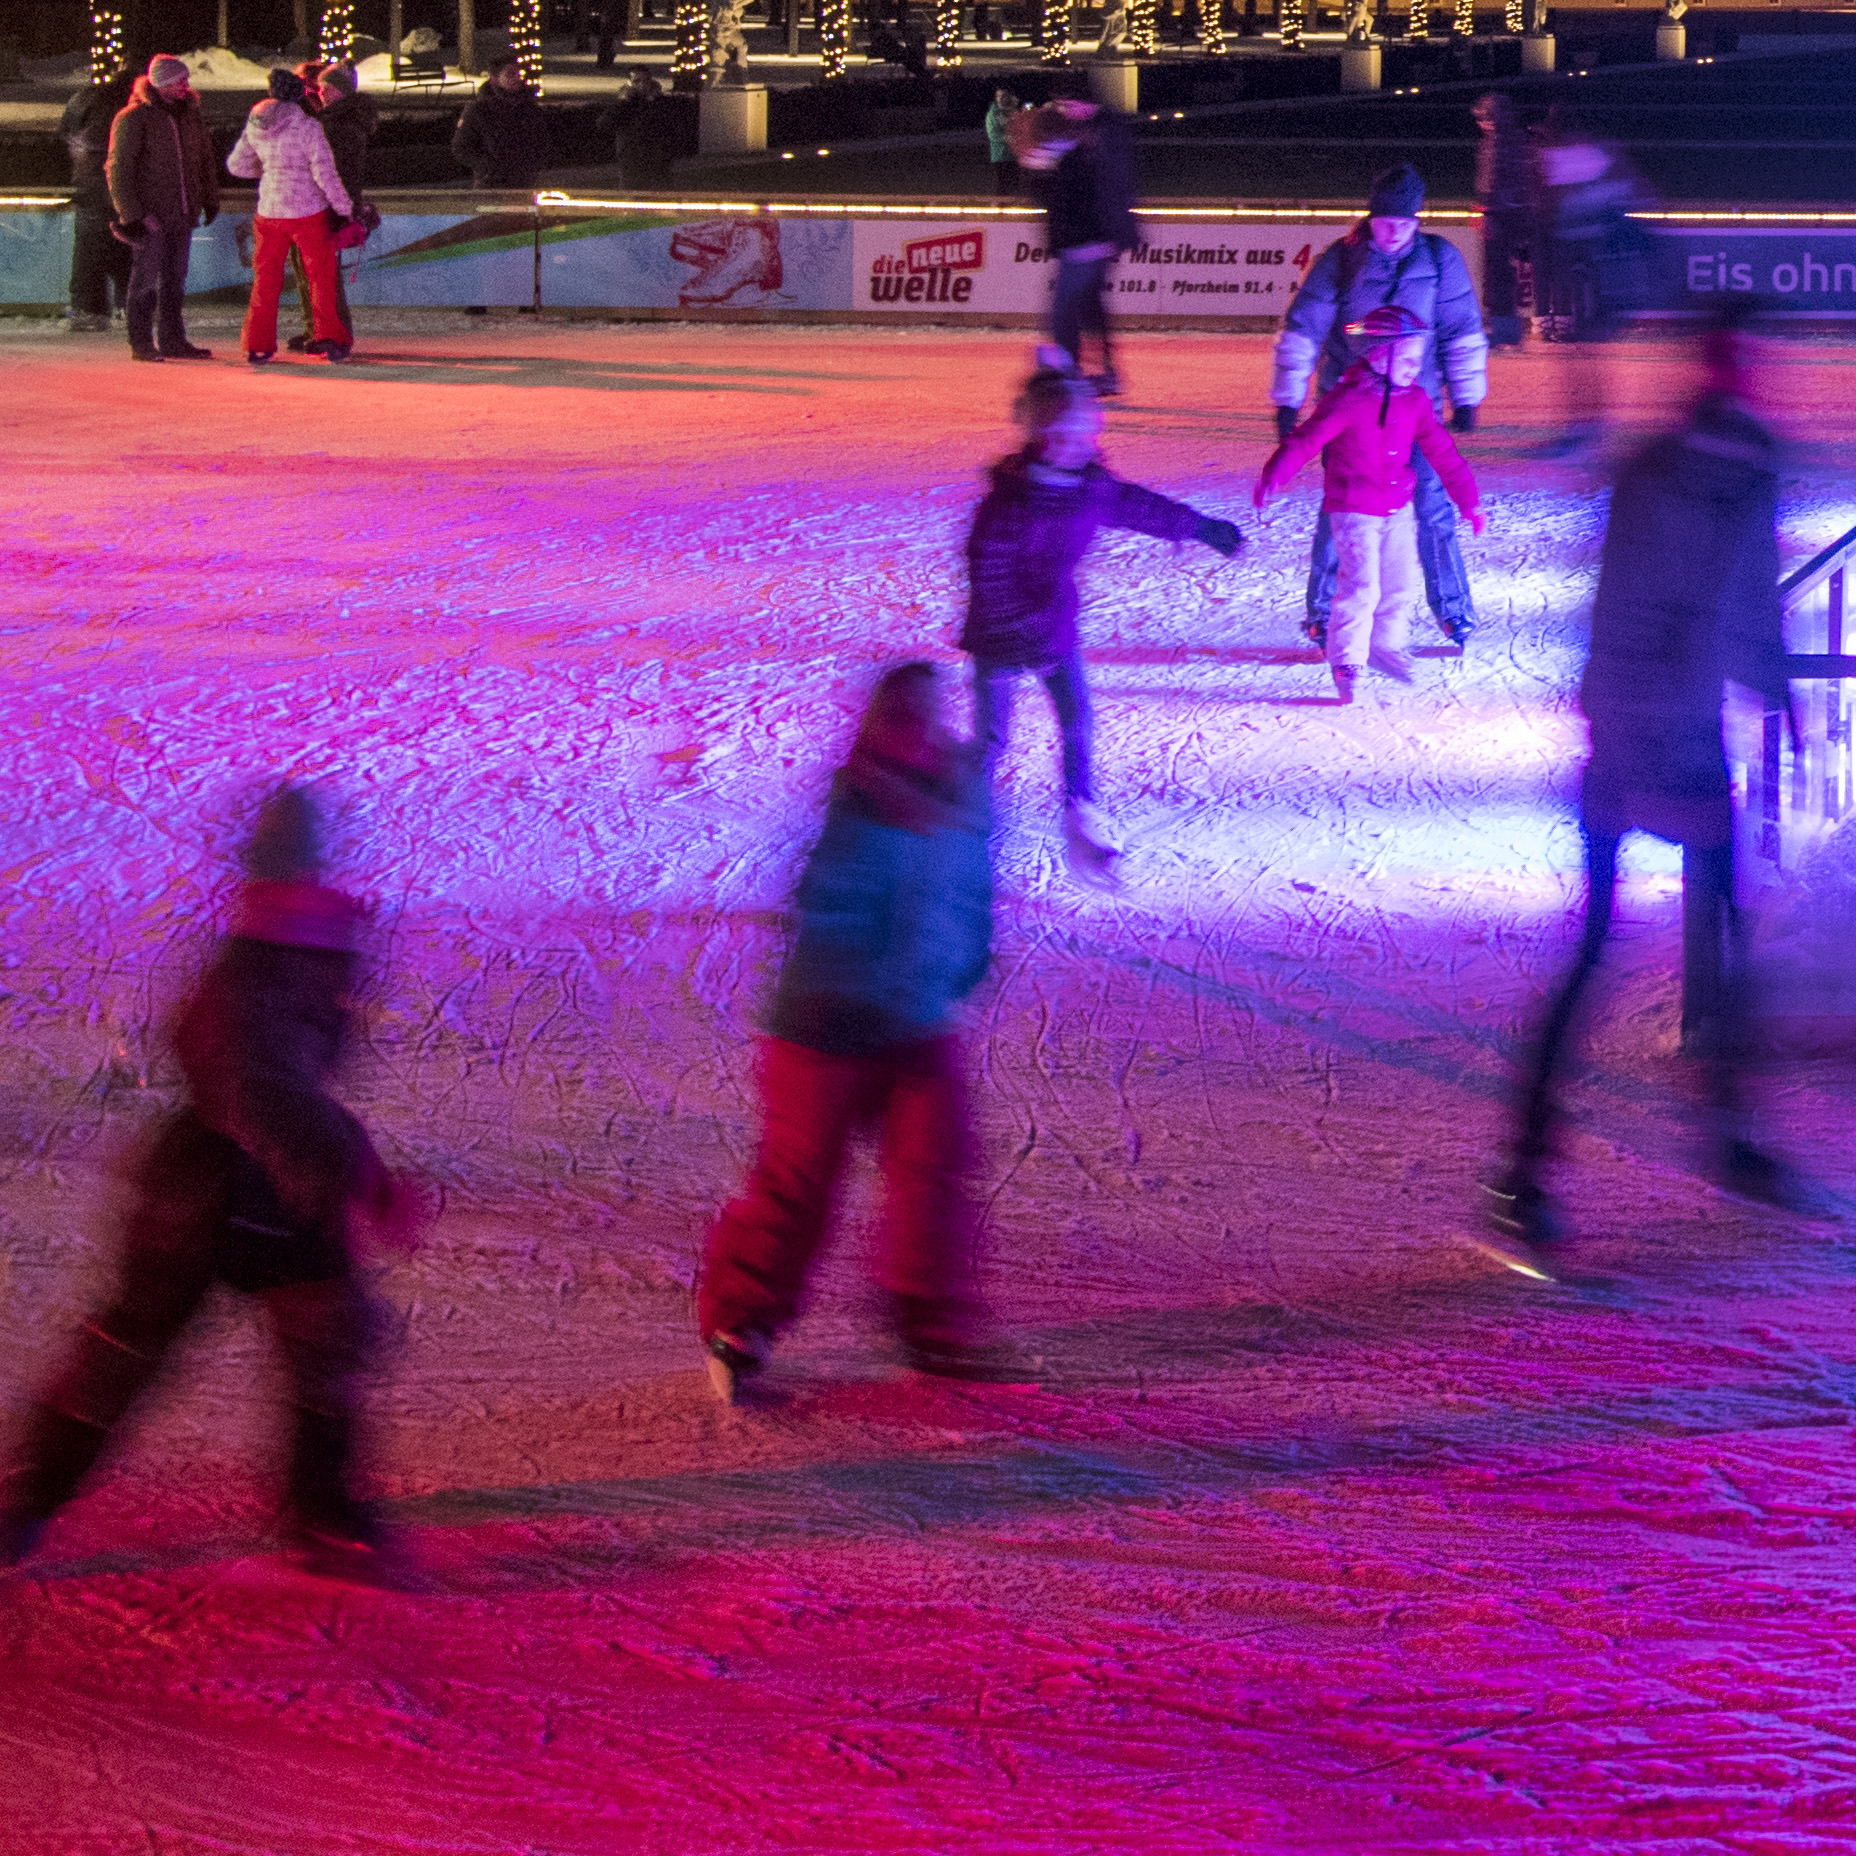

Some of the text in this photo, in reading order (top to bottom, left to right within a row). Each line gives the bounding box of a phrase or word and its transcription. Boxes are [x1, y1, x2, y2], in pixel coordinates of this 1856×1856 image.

[872, 240, 977, 275] die neue
[1130, 243, 1238, 265] Musikmix
[1245, 247, 1285, 265] aus
[1291, 243, 1312, 271] 4
[1686, 251, 1753, 292] Eis
[870, 266, 973, 303] welle
[1119, 279, 1157, 293] 101.8
[1172, 279, 1240, 296] Pforzheim
[1244, 280, 1274, 294] 91.4
